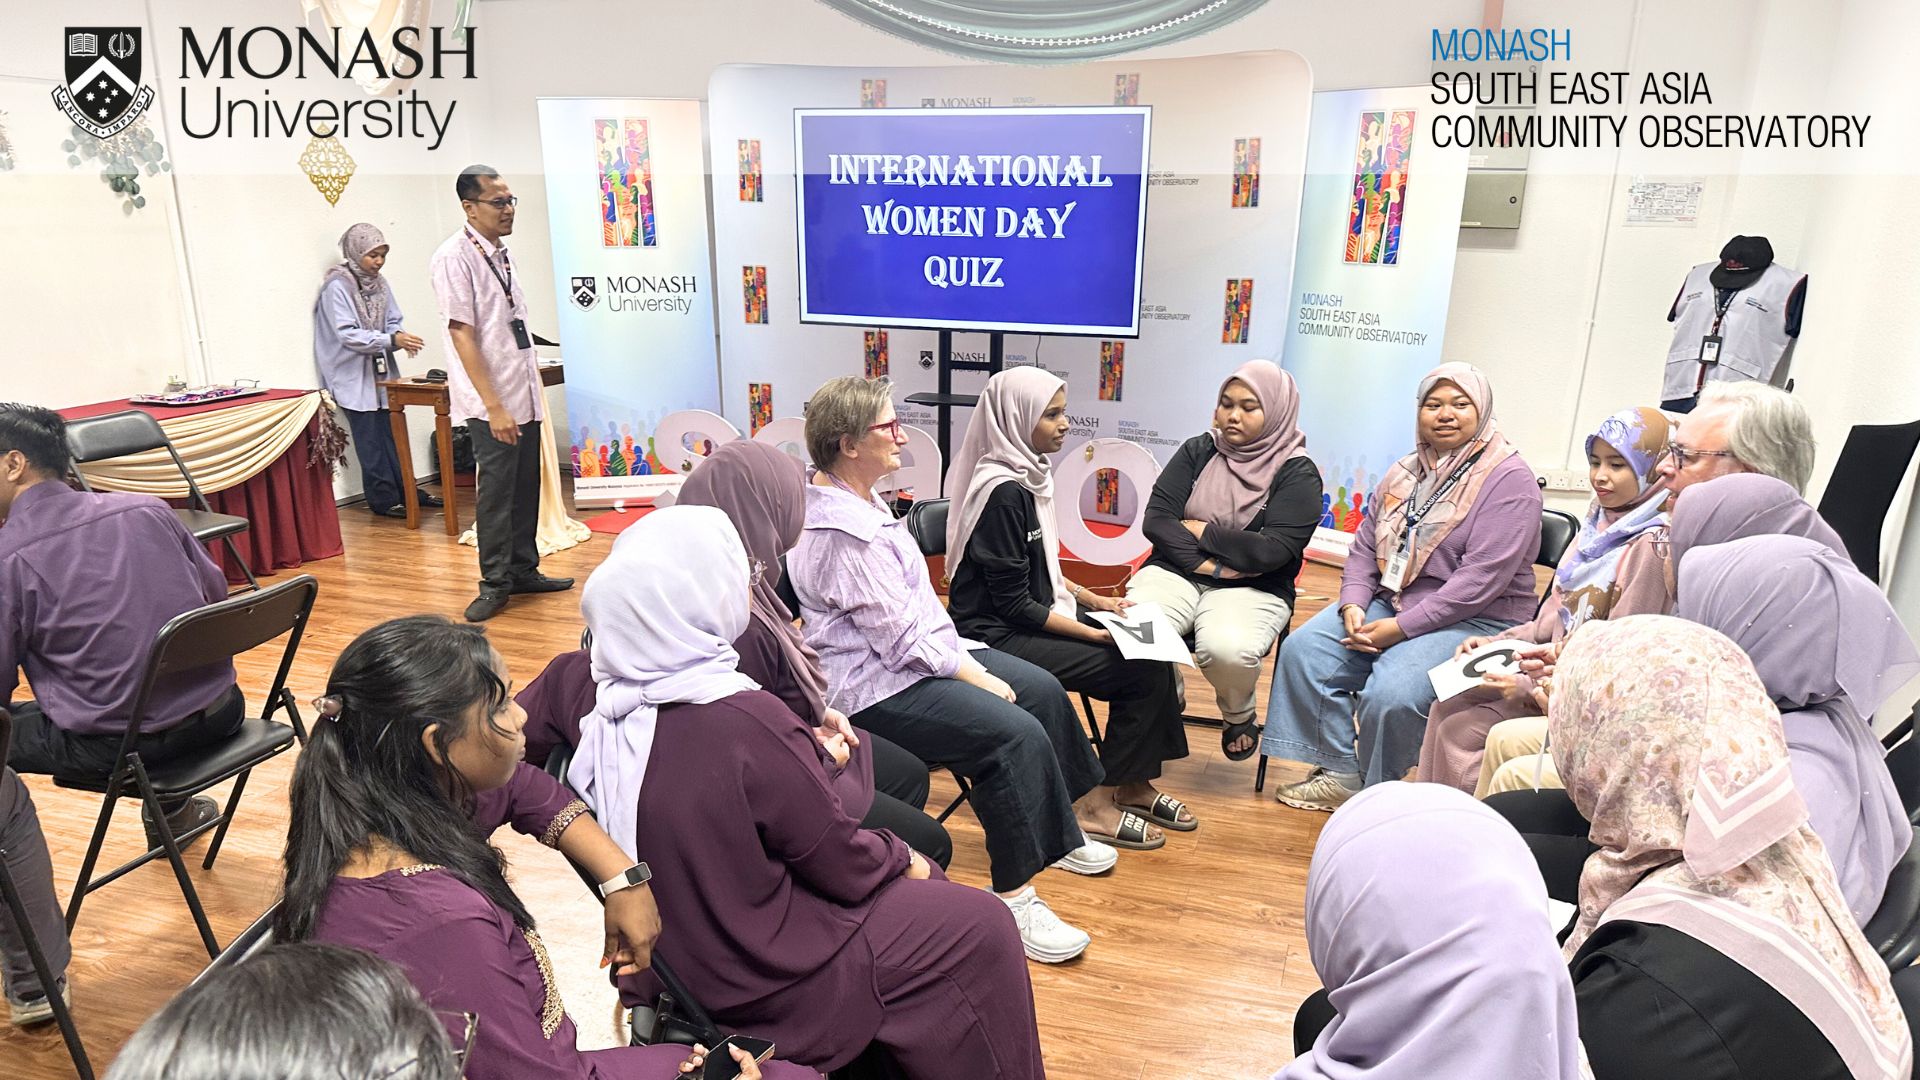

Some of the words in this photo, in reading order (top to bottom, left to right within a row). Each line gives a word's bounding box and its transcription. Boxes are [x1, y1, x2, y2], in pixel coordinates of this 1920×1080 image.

[828, 153, 1113, 188] INTERNATIONAL
[861, 198, 985, 238] WOMEN
[995, 200, 1077, 240] DAY
[606, 276, 697, 293] MONASH
[923, 255, 1005, 289] QUIZ
[608, 295, 692, 315] University
[1301, 293, 1343, 307] MONASH
[1299, 307, 1331, 321] SOUTH
[1332, 310, 1357, 324] EAST
[1357, 313, 1381, 326] ASIA
[1298, 322, 1354, 339] COMMUNITY
[1355, 327, 1428, 346] OBSERVATORY
[1109, 619, 1154, 645] A
[1462, 648, 1516, 678] C
